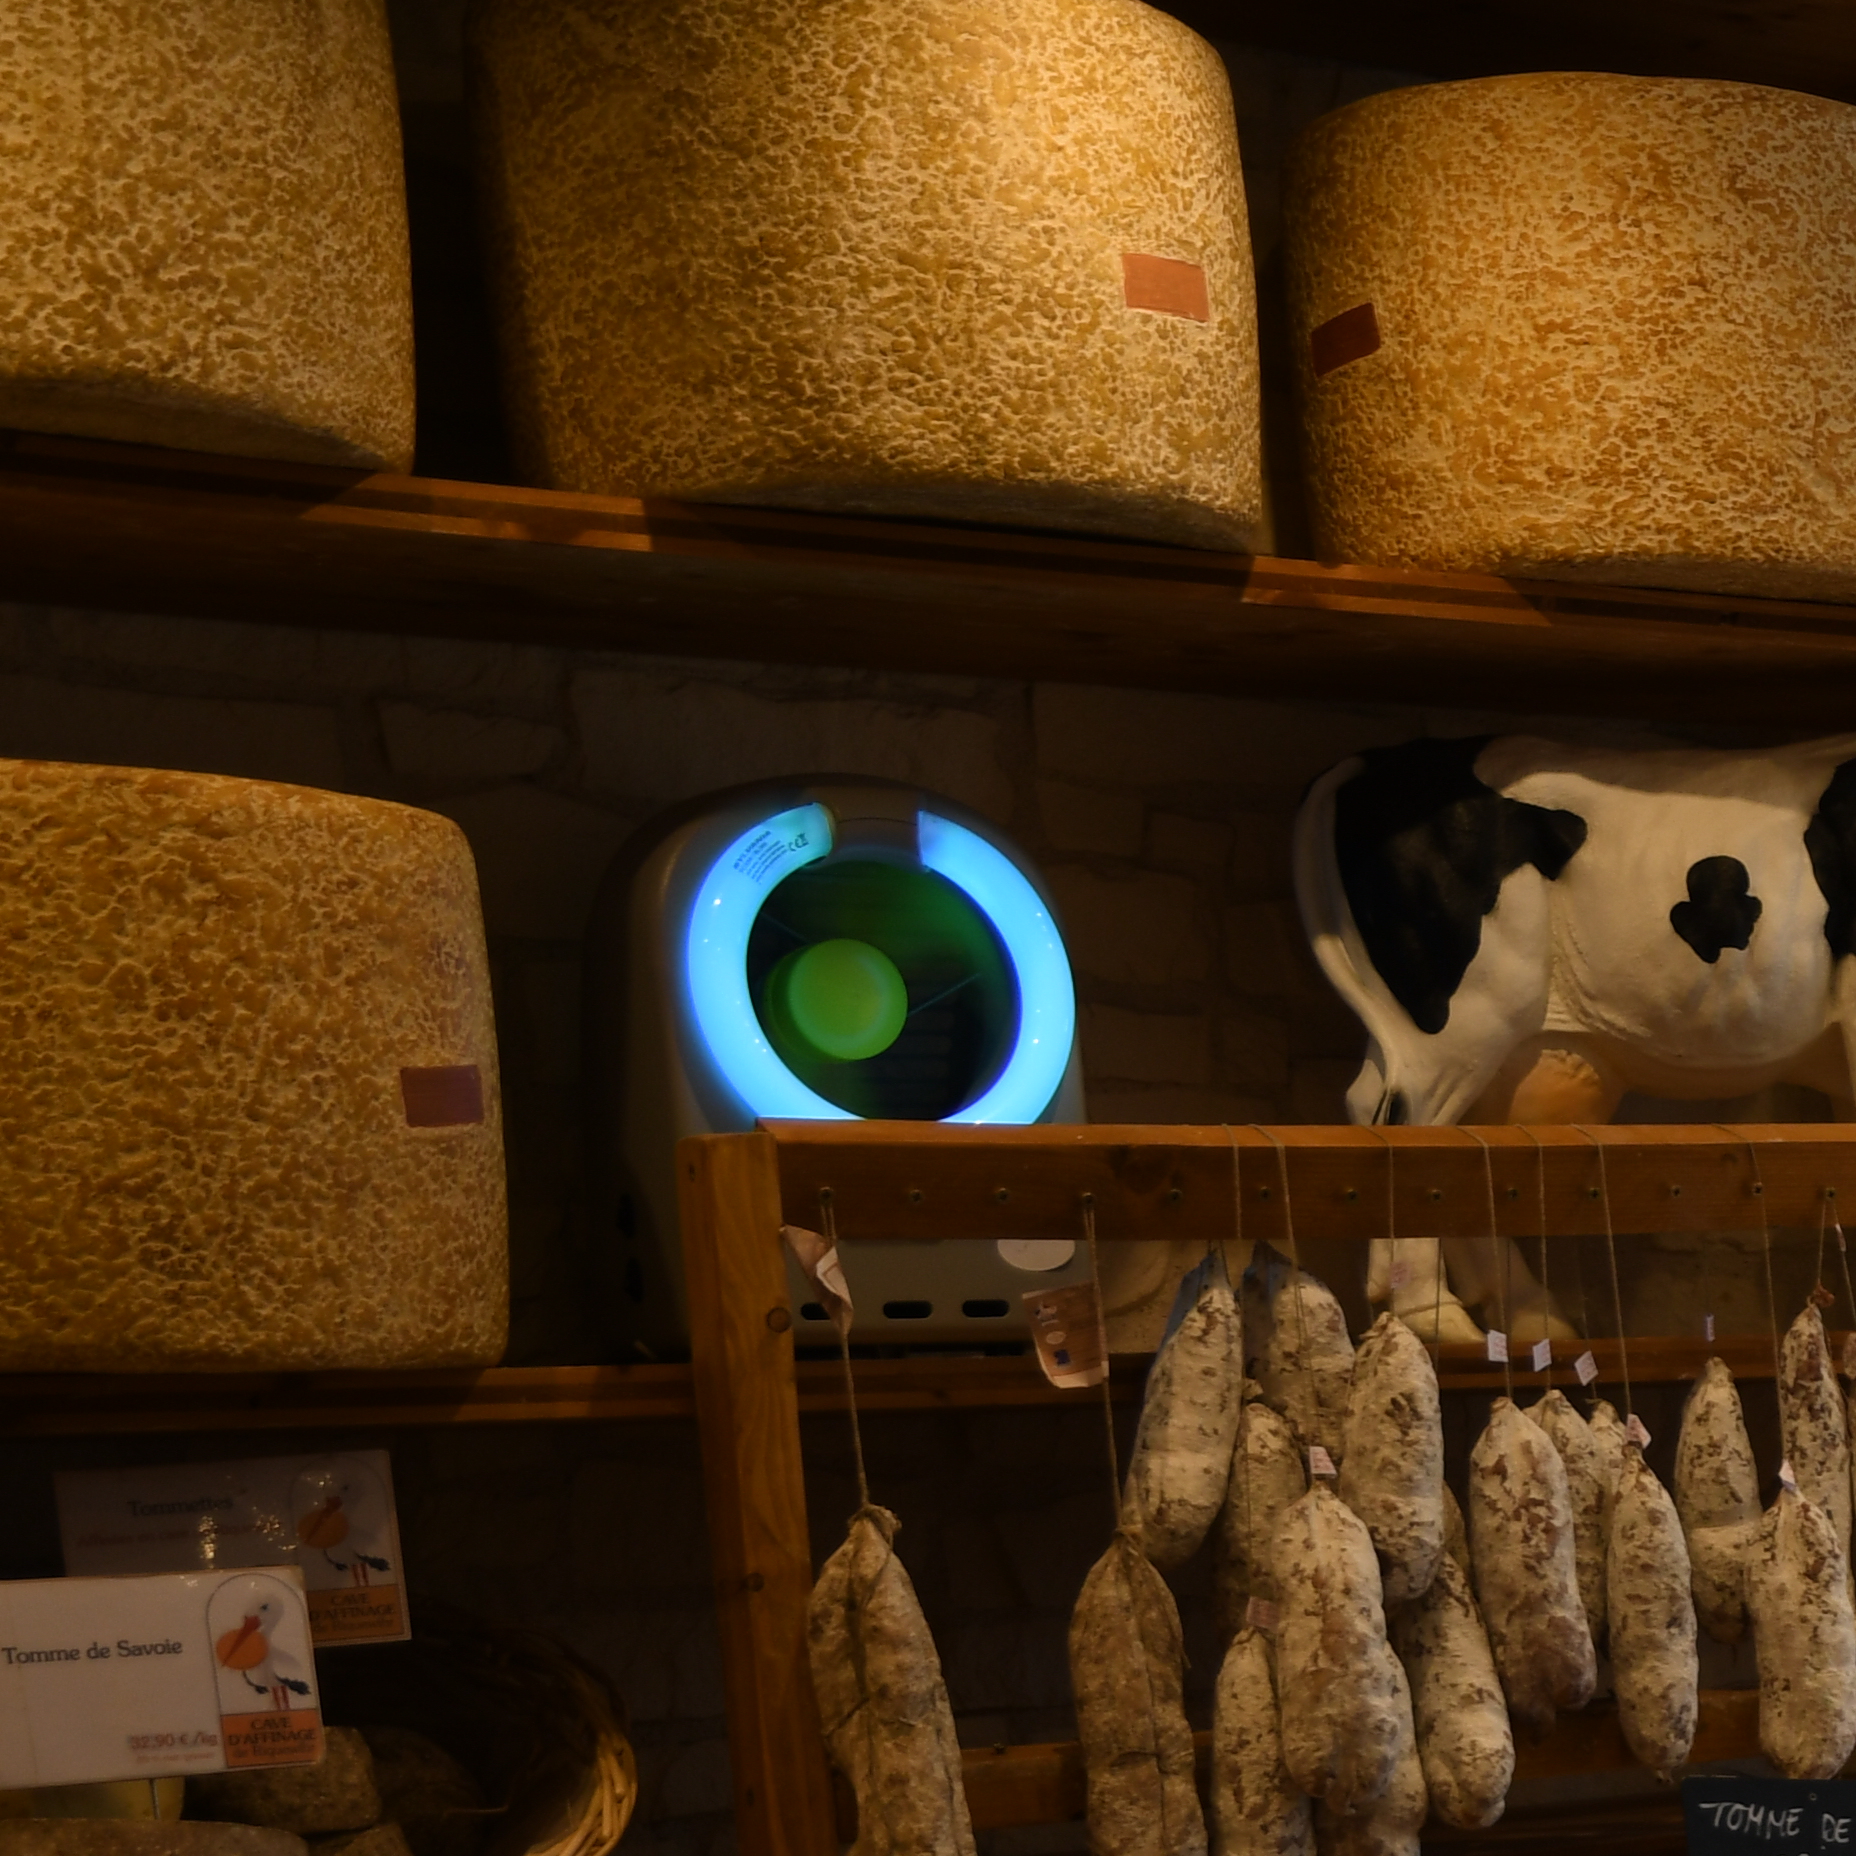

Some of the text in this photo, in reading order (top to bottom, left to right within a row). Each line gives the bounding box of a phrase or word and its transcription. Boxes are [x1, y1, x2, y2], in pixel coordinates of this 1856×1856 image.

[2, 1639, 183, 1665] Tomme de Savoie
[1699, 1802, 1804, 1840] TOMME
[1821, 1812, 1852, 1843] DE
